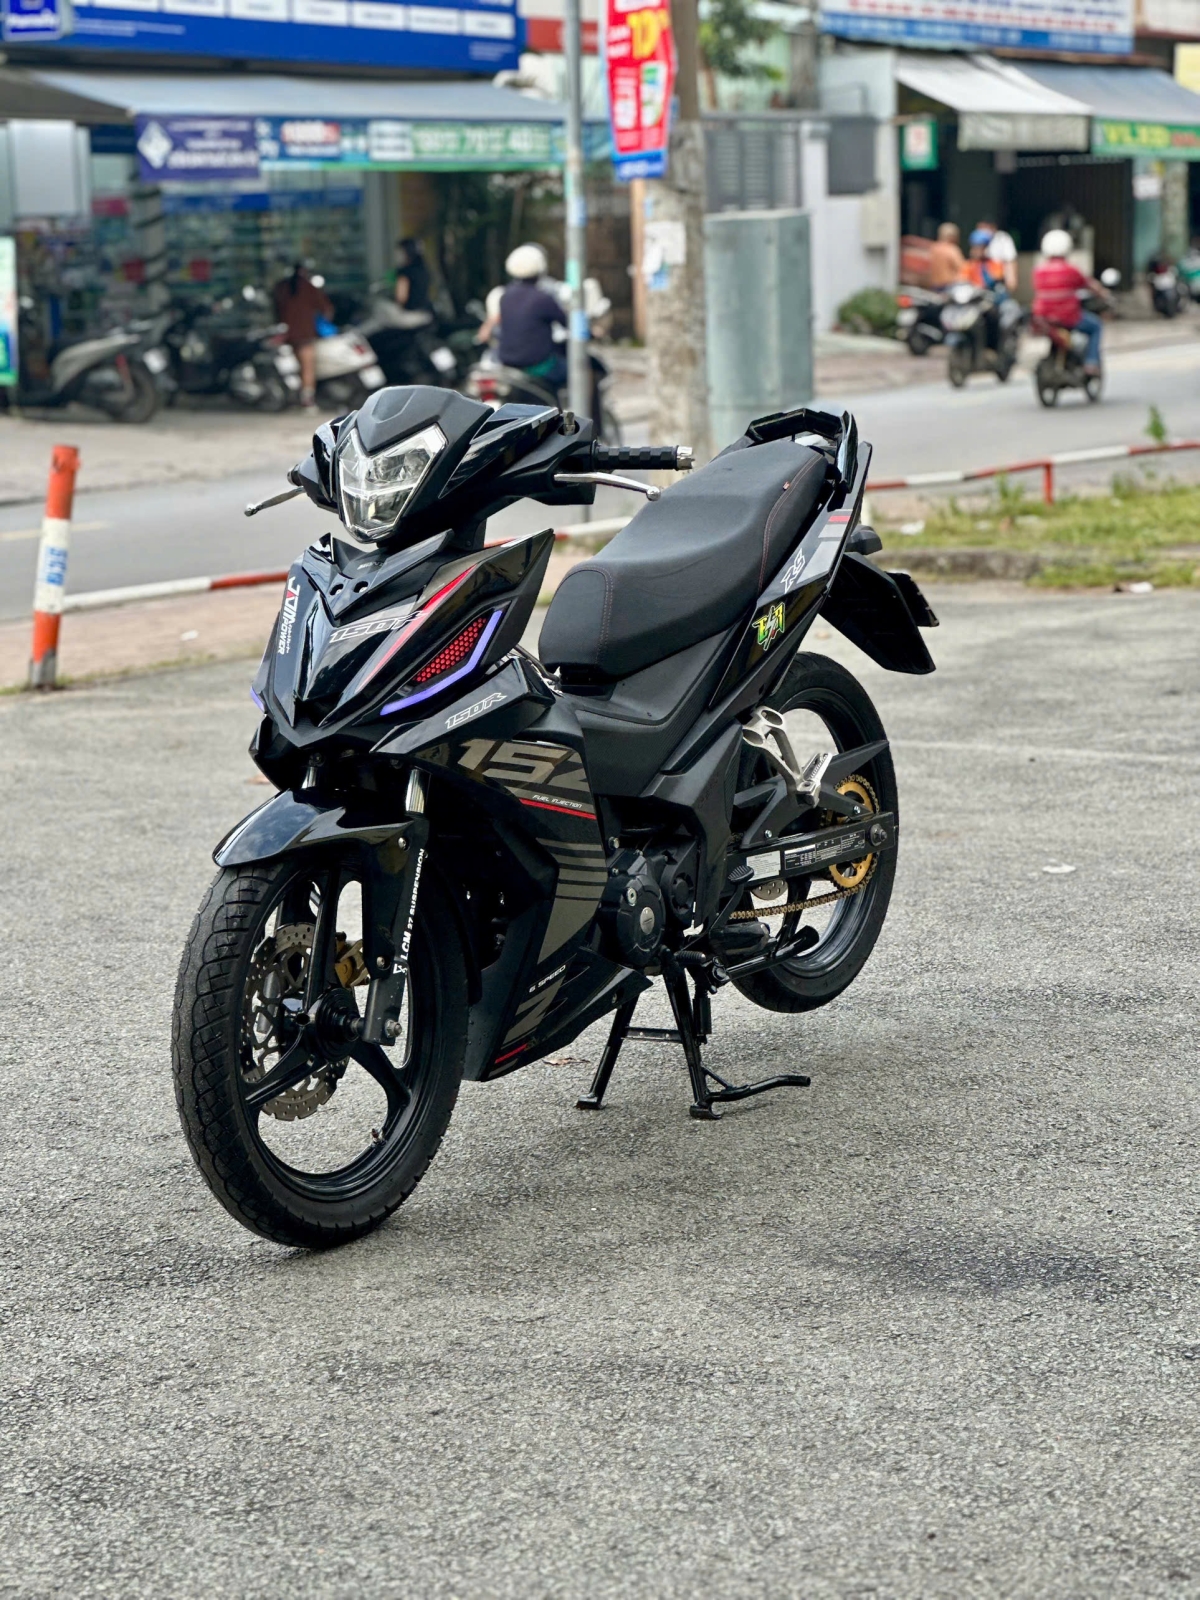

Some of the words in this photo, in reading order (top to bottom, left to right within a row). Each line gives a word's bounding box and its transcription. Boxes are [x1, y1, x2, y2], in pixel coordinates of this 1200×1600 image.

[278, 616, 289, 655] POWER
[445, 692, 508, 729] 150R
[532, 794, 550, 802] FUEL
[551, 798, 583, 809] INJECTION
[400, 931, 412, 960] LCM
[409, 848, 425, 916] SUSPENSION
[537, 964, 567, 988] SPEED
